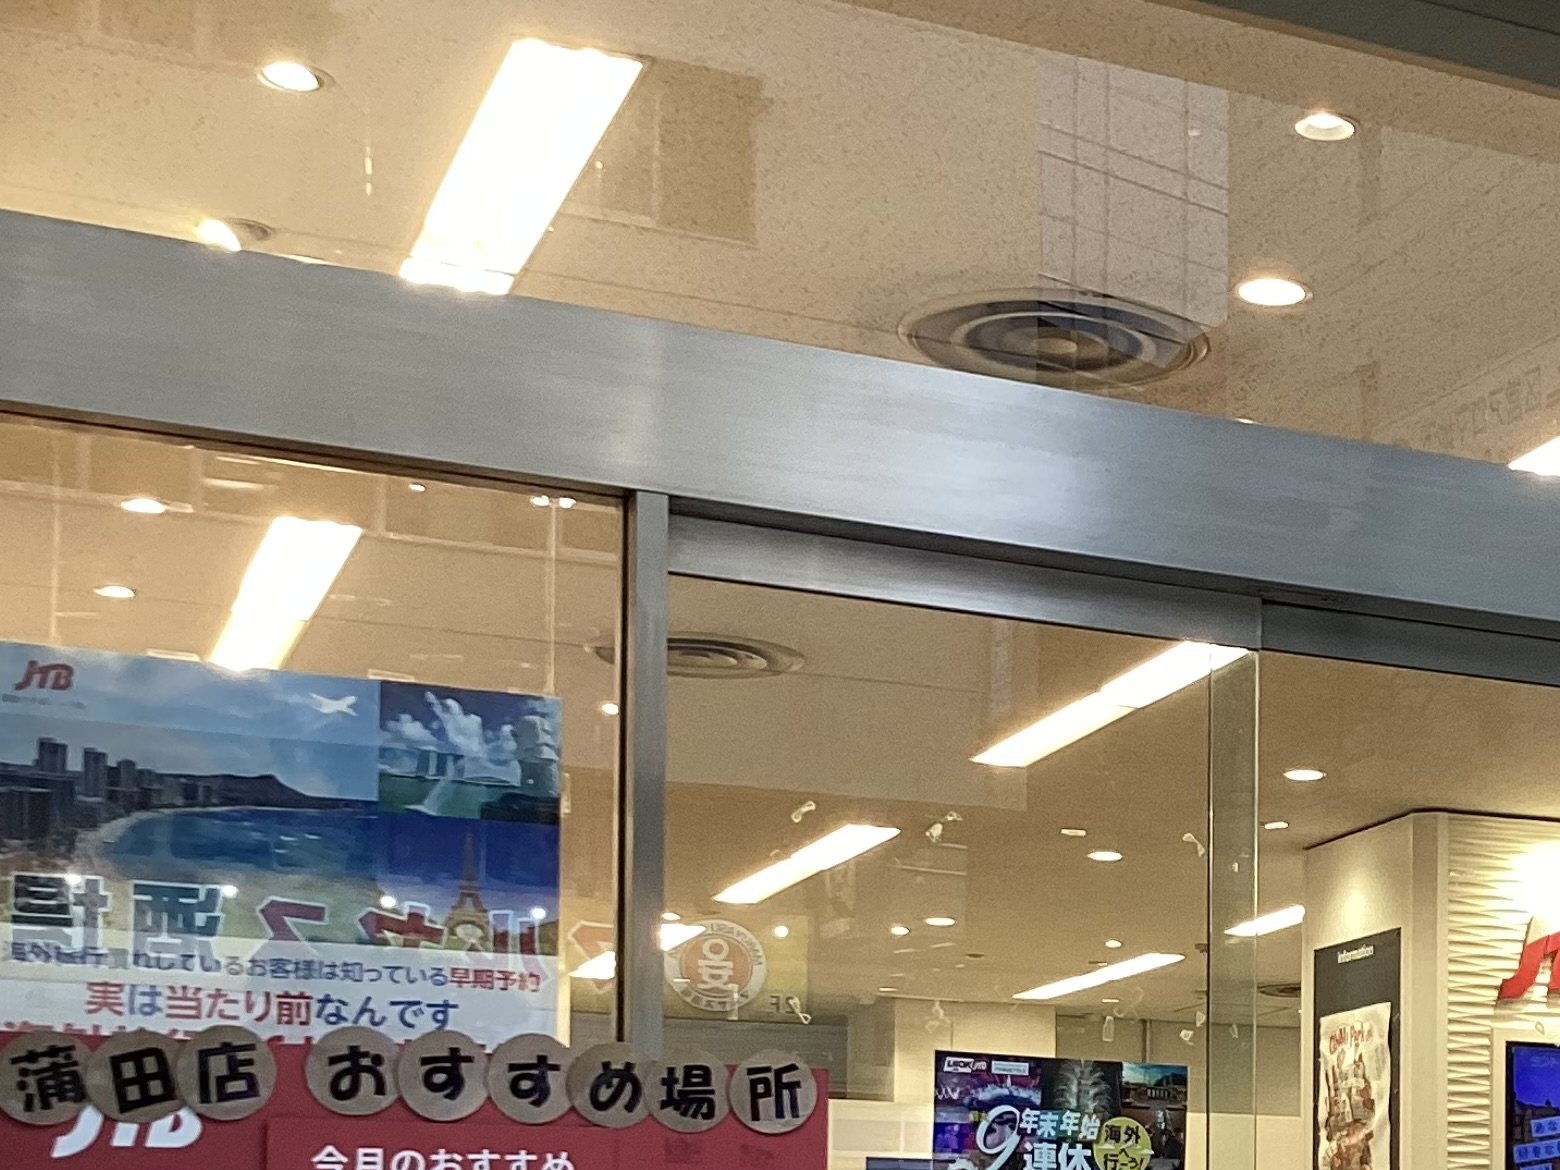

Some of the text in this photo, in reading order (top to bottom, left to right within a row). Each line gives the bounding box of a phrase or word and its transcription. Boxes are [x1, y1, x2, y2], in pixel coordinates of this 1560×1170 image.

[14, 660, 75, 691] JTB
[84, 980, 460, 1031] 実は当たり前なんです
[11, 1041, 802, 1122] 蒲田店 おすすめ場所
[1020, 1107, 1101, 1140] 年末年始
[1105, 1124, 1141, 1144] 海外
